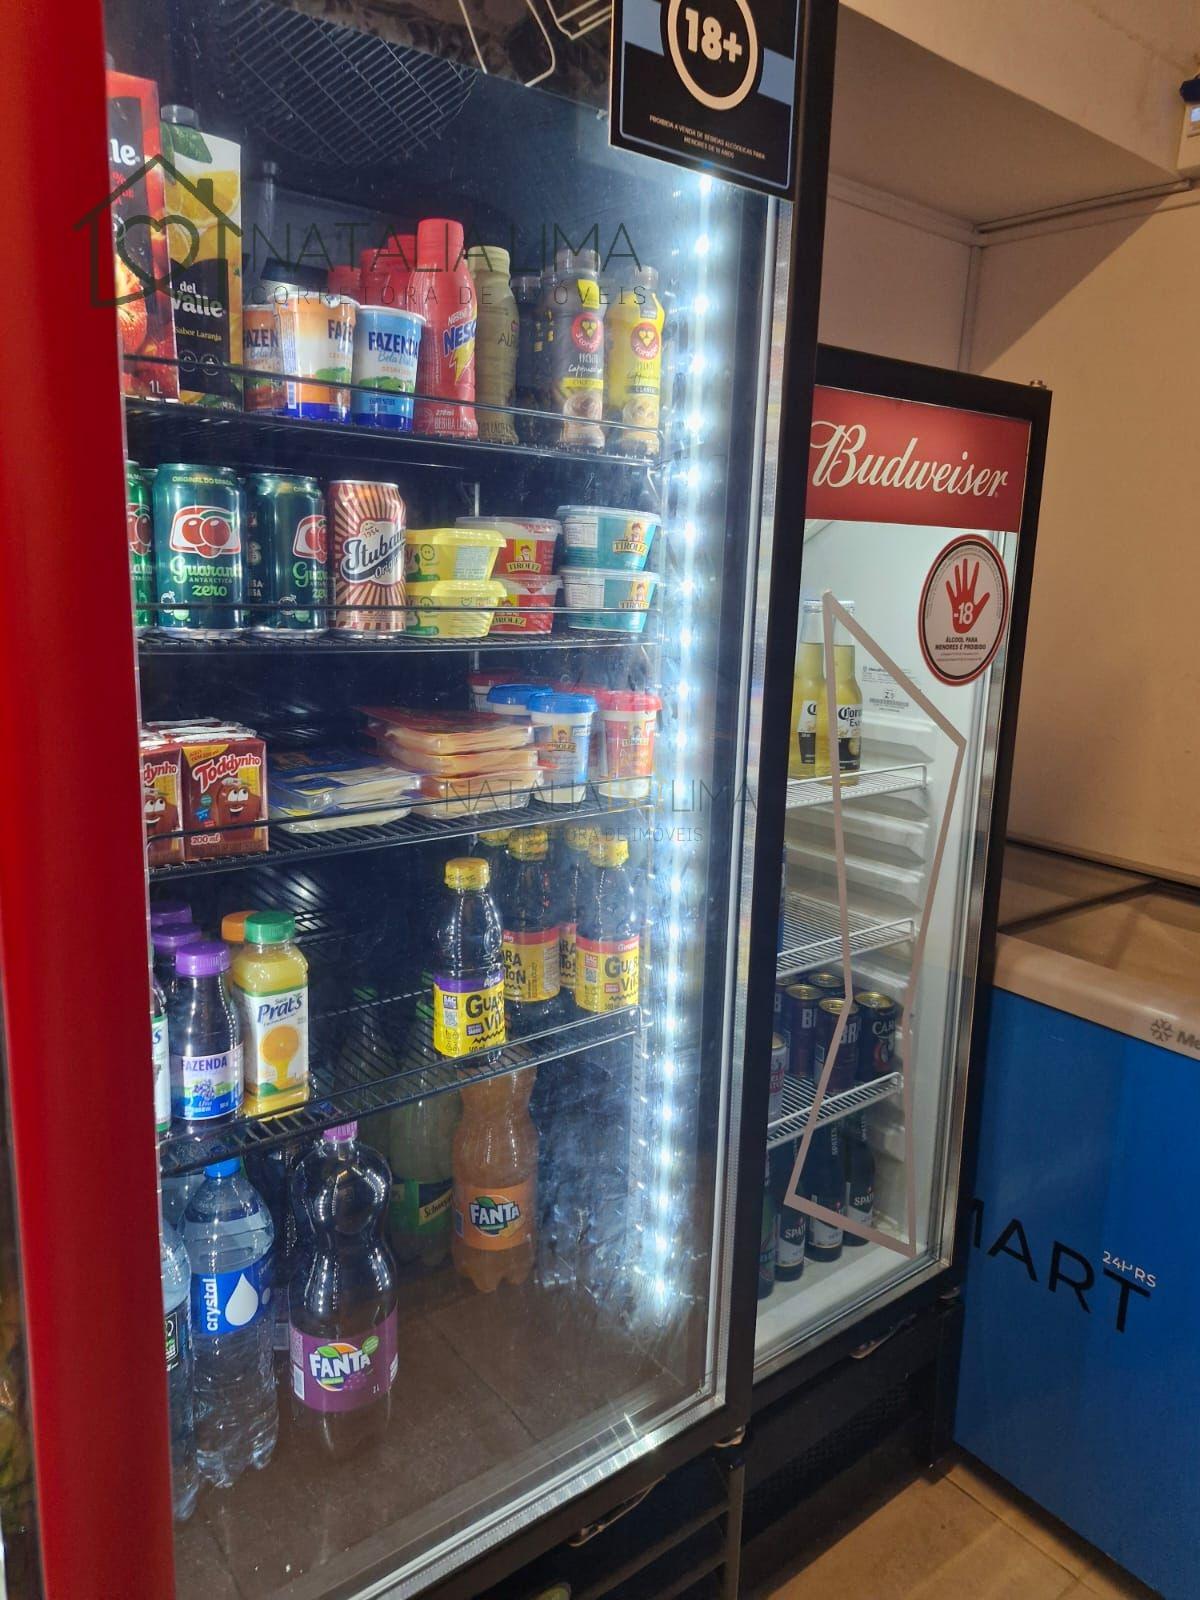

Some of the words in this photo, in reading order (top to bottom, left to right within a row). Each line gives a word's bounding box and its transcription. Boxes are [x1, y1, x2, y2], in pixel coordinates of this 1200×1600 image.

[684, 7, 743, 63] 18+
[179, 280, 197, 294] del
[148, 380, 163, 394] 1L
[809, 420, 1008, 498] Budweiser
[192, 752, 262, 794] Toddynho
[470, 1203, 520, 1225] FANTA
[202, 1277, 218, 1332] crystal
[309, 1349, 371, 1378] FANTA
